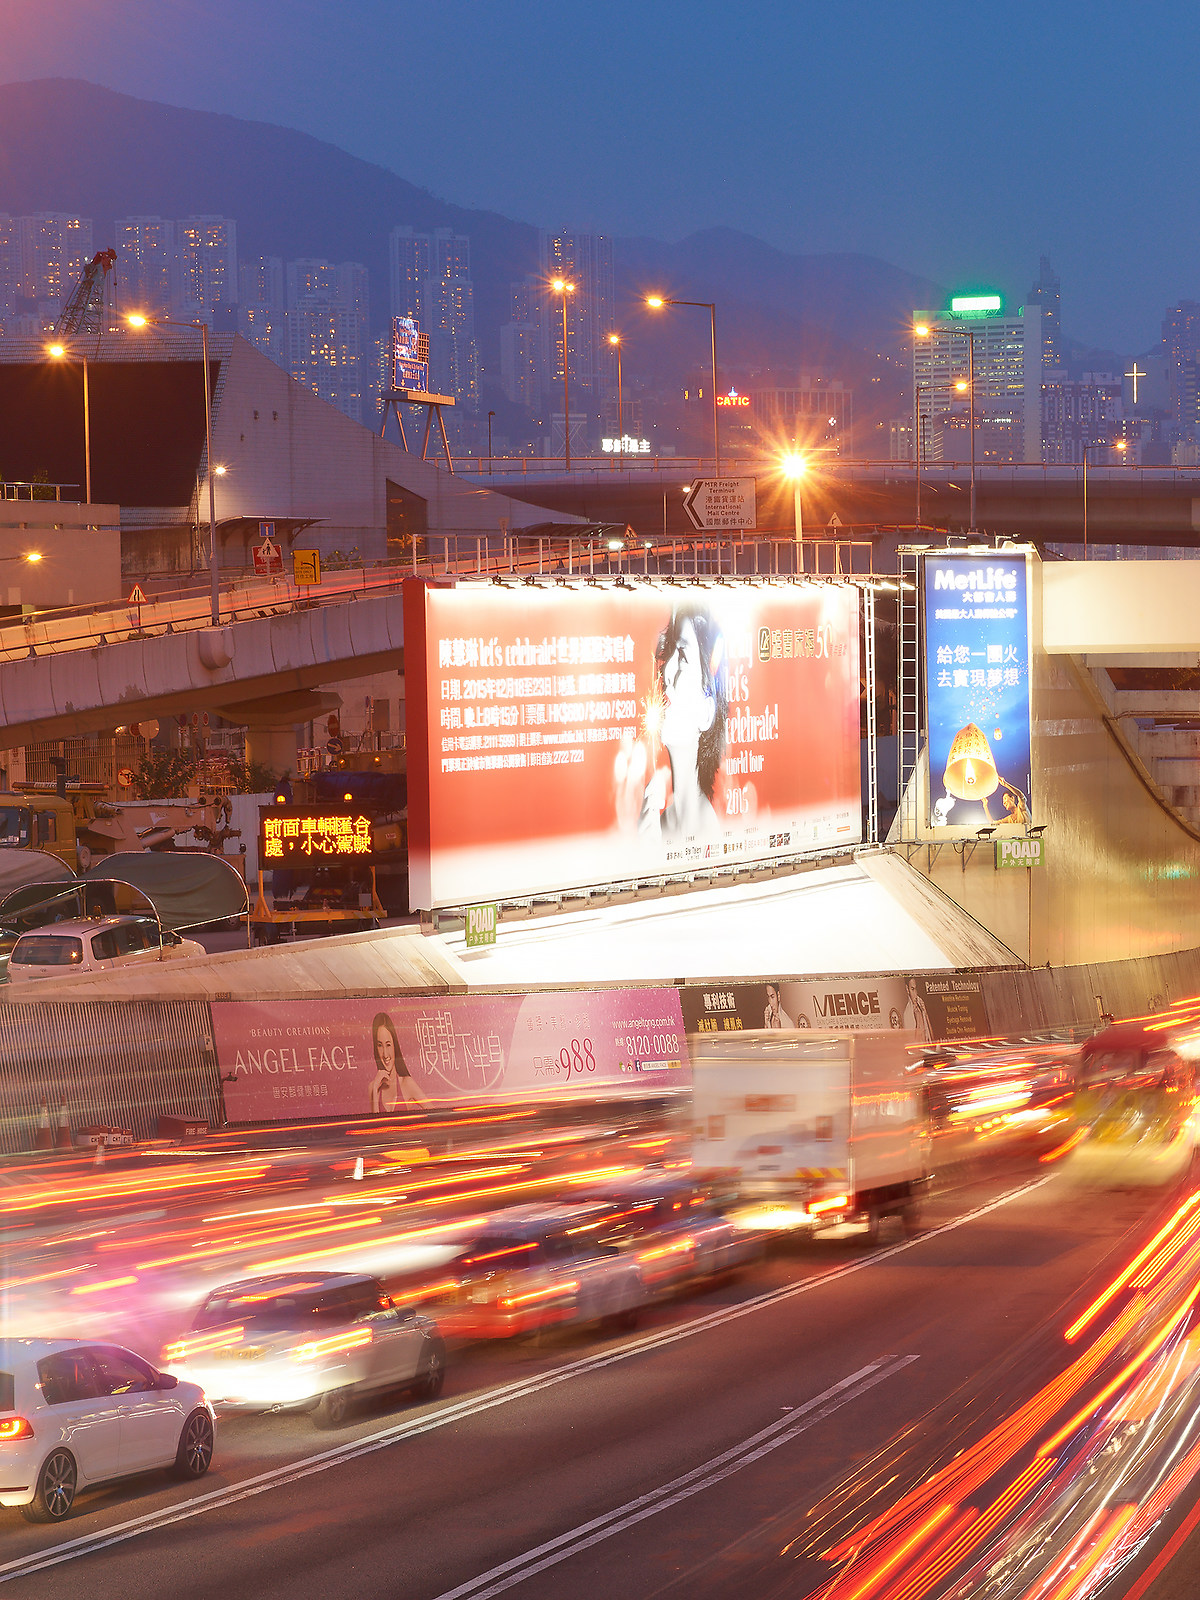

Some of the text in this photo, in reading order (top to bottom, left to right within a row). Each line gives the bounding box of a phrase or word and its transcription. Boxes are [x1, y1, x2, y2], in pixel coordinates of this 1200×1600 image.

[717, 397, 750, 406] CATIC
[934, 567, 1017, 590] MetLife
[726, 665, 749, 702] let's
[725, 704, 779, 745] celebrate!
[264, 815, 372, 838] 前面車輛匯合
[1002, 841, 1040, 858] POAD
[469, 907, 494, 934] POAD
[925, 979, 980, 993] Patented Technology
[251, 1026, 331, 1038] BEAUTY CREATIONS
[625, 1034, 680, 1056] 8120-0088
[234, 1045, 358, 1075] ANGEL FACE
